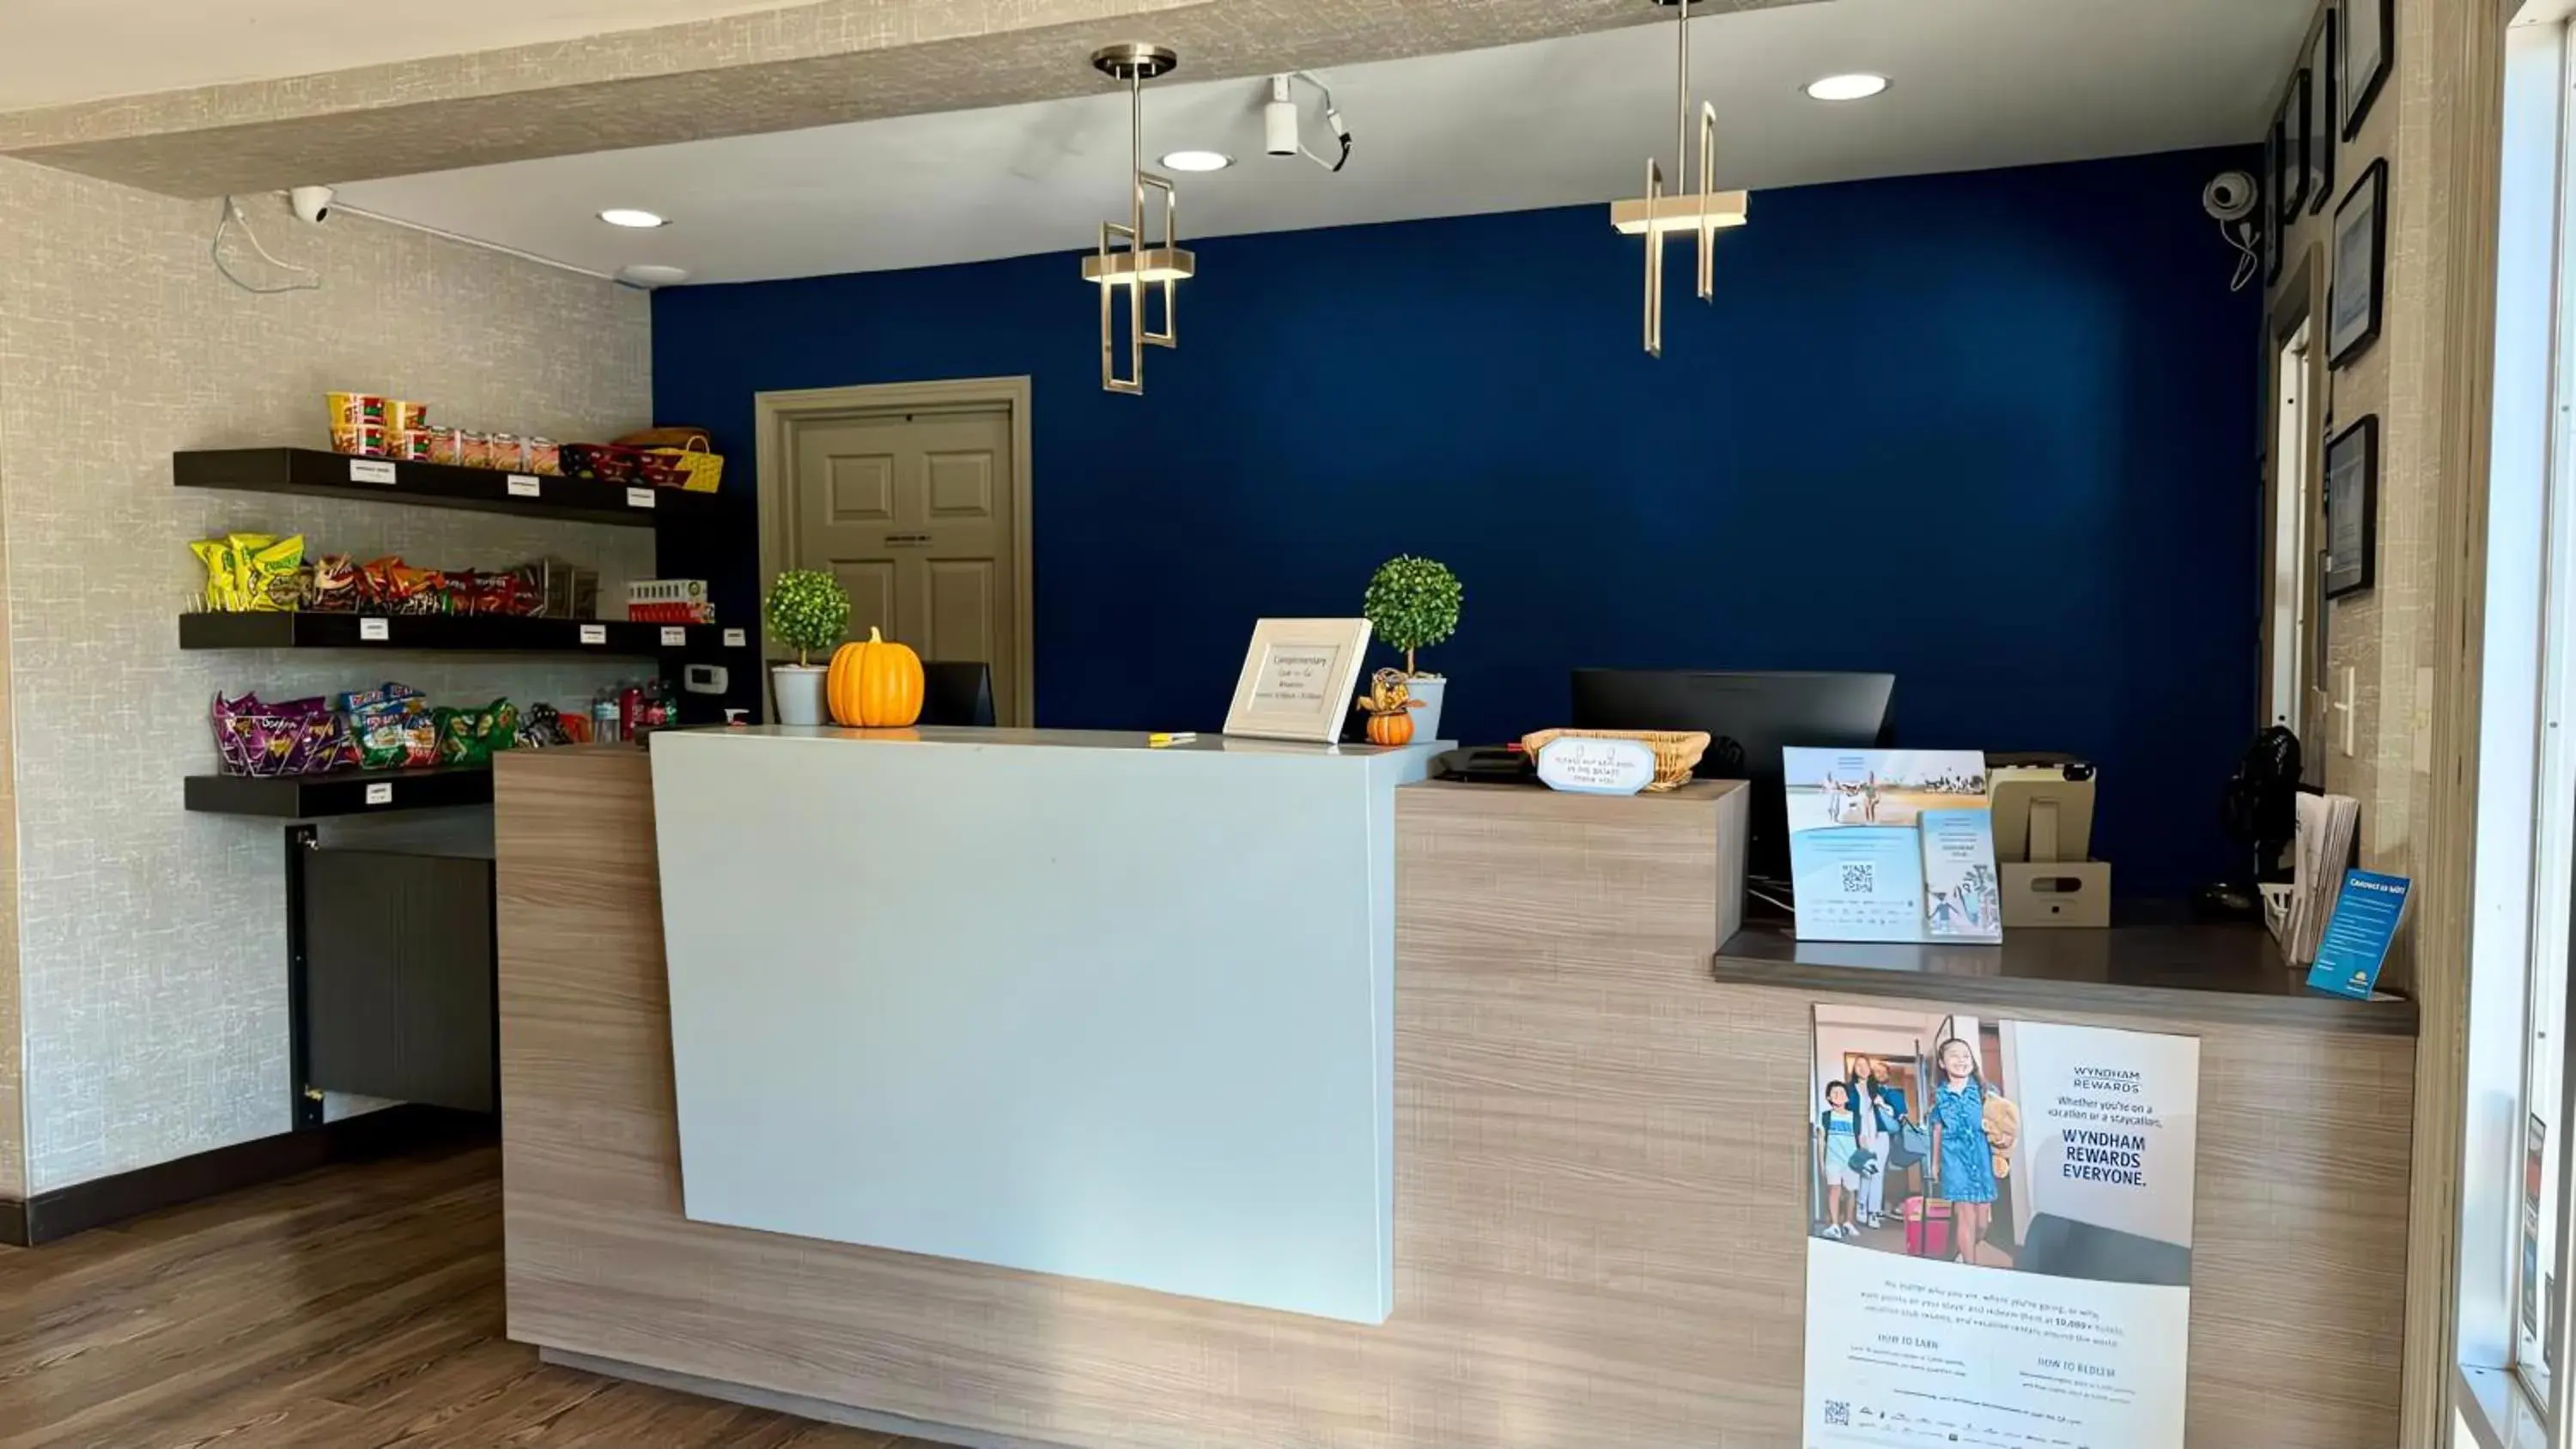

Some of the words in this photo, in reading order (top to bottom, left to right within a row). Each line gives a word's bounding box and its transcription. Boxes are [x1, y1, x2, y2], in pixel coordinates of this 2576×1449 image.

[2074, 1066, 2141, 1081] WYNDHAM
[2074, 1079, 2140, 1094] REWARDS
[2057, 1095, 2098, 1108] Whether
[2131, 1104, 2144, 1113] on
[2146, 1105, 2154, 1114] a
[2062, 1128, 2146, 1152] WYNDHAM
[2066, 1146, 2142, 1169] REWARDS
[2063, 1163, 2148, 1187] EVERYONE.
